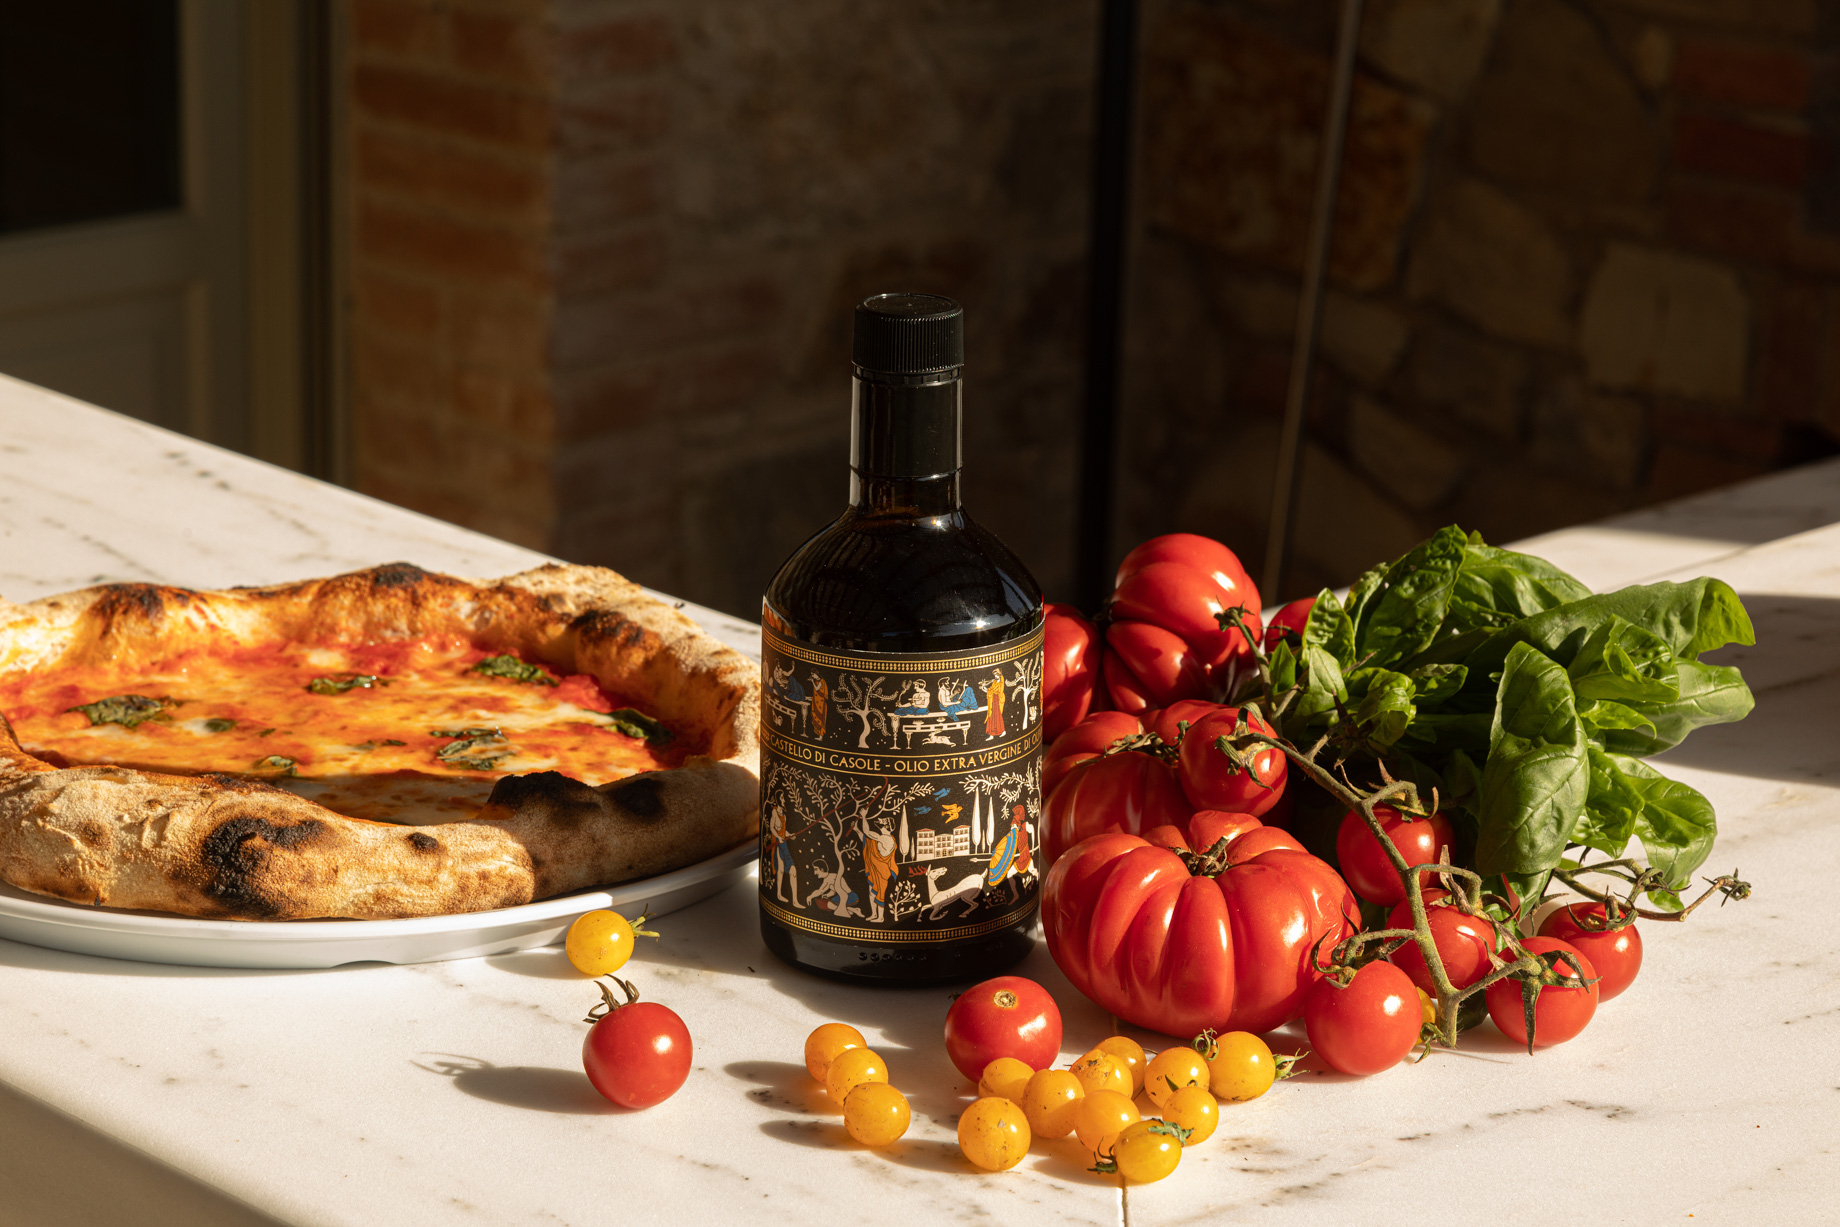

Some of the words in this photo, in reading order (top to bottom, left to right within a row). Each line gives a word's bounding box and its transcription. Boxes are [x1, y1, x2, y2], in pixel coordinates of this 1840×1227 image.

[770, 734, 812, 760] CASTELLO
[814, 750, 826, 764] DI
[829, 754, 881, 771] CASOLE
[894, 760, 930, 773] OLIO
[934, 757, 977, 771] EXTRA
[979, 742, 1022, 765] VERGINE
[1023, 737, 1031, 751] DI
